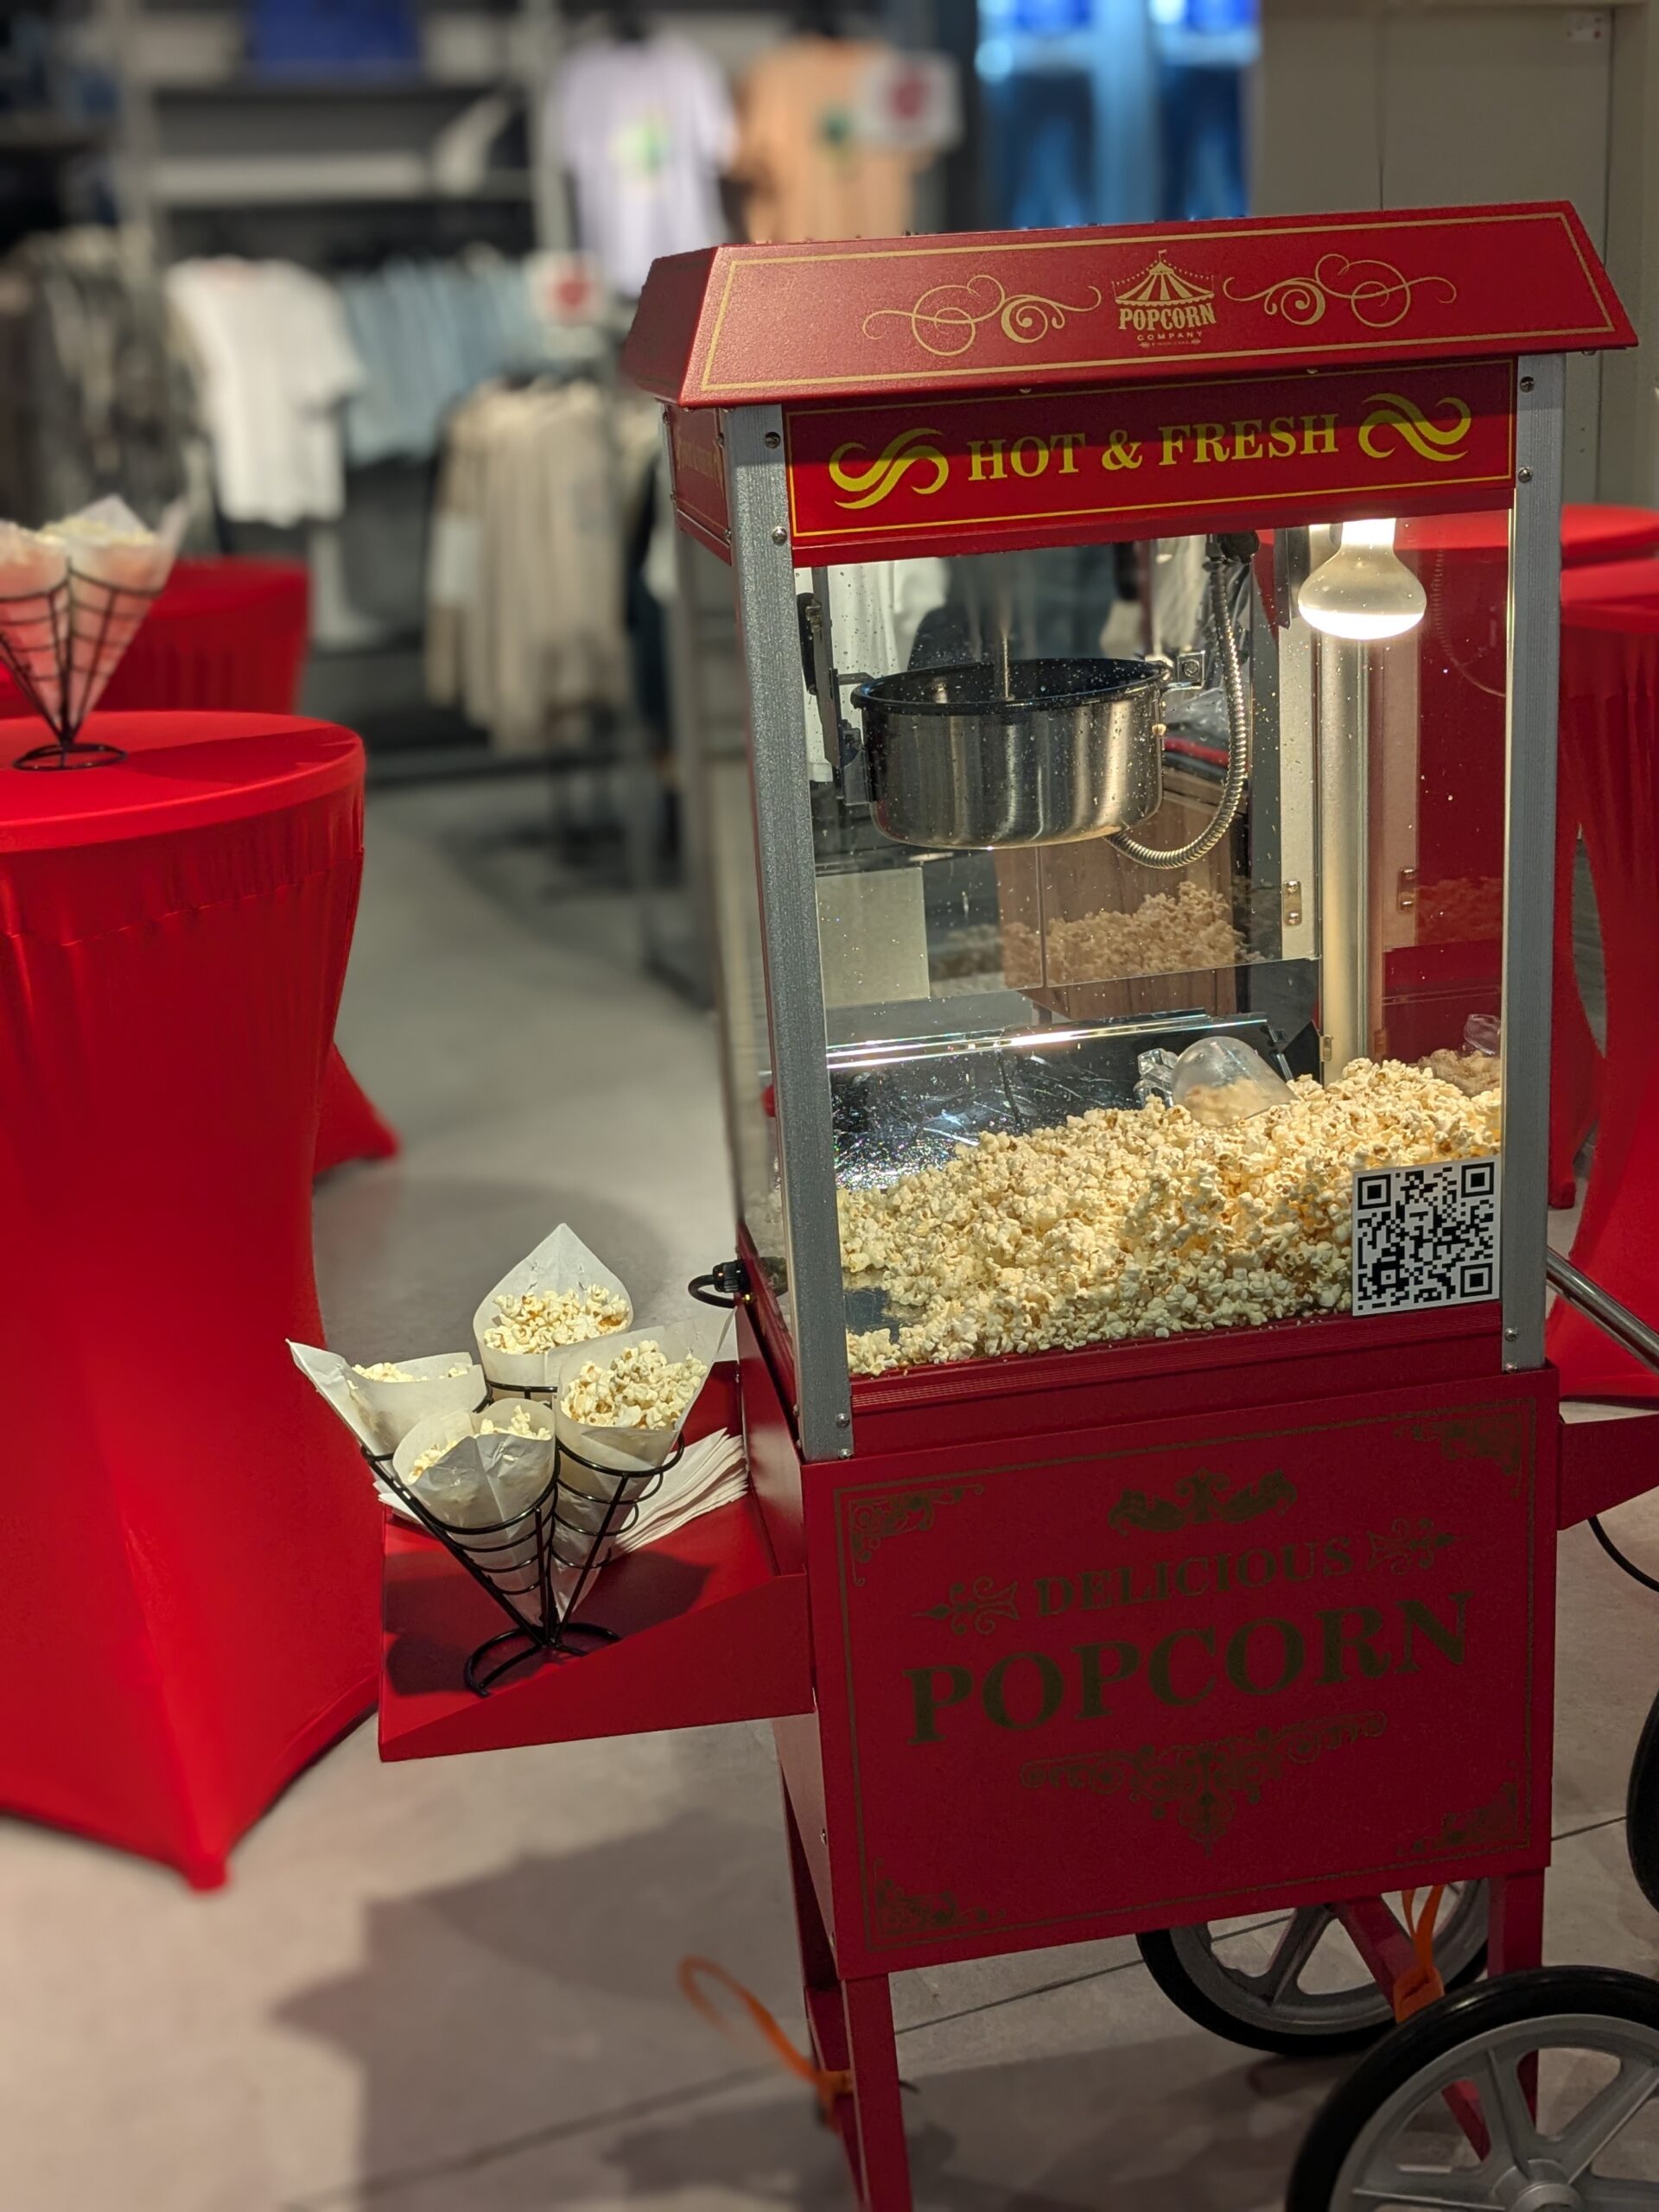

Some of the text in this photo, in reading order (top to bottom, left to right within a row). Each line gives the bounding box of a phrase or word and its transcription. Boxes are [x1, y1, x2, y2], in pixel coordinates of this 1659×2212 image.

[1118, 302, 1217, 331] POPCORN
[1137, 330, 1203, 341] COMPANY
[967, 413, 1339, 481] HOT & FRESH
[1033, 1536, 1353, 1618] DELICIOUS
[902, 1590, 1475, 1745] POPCORN
